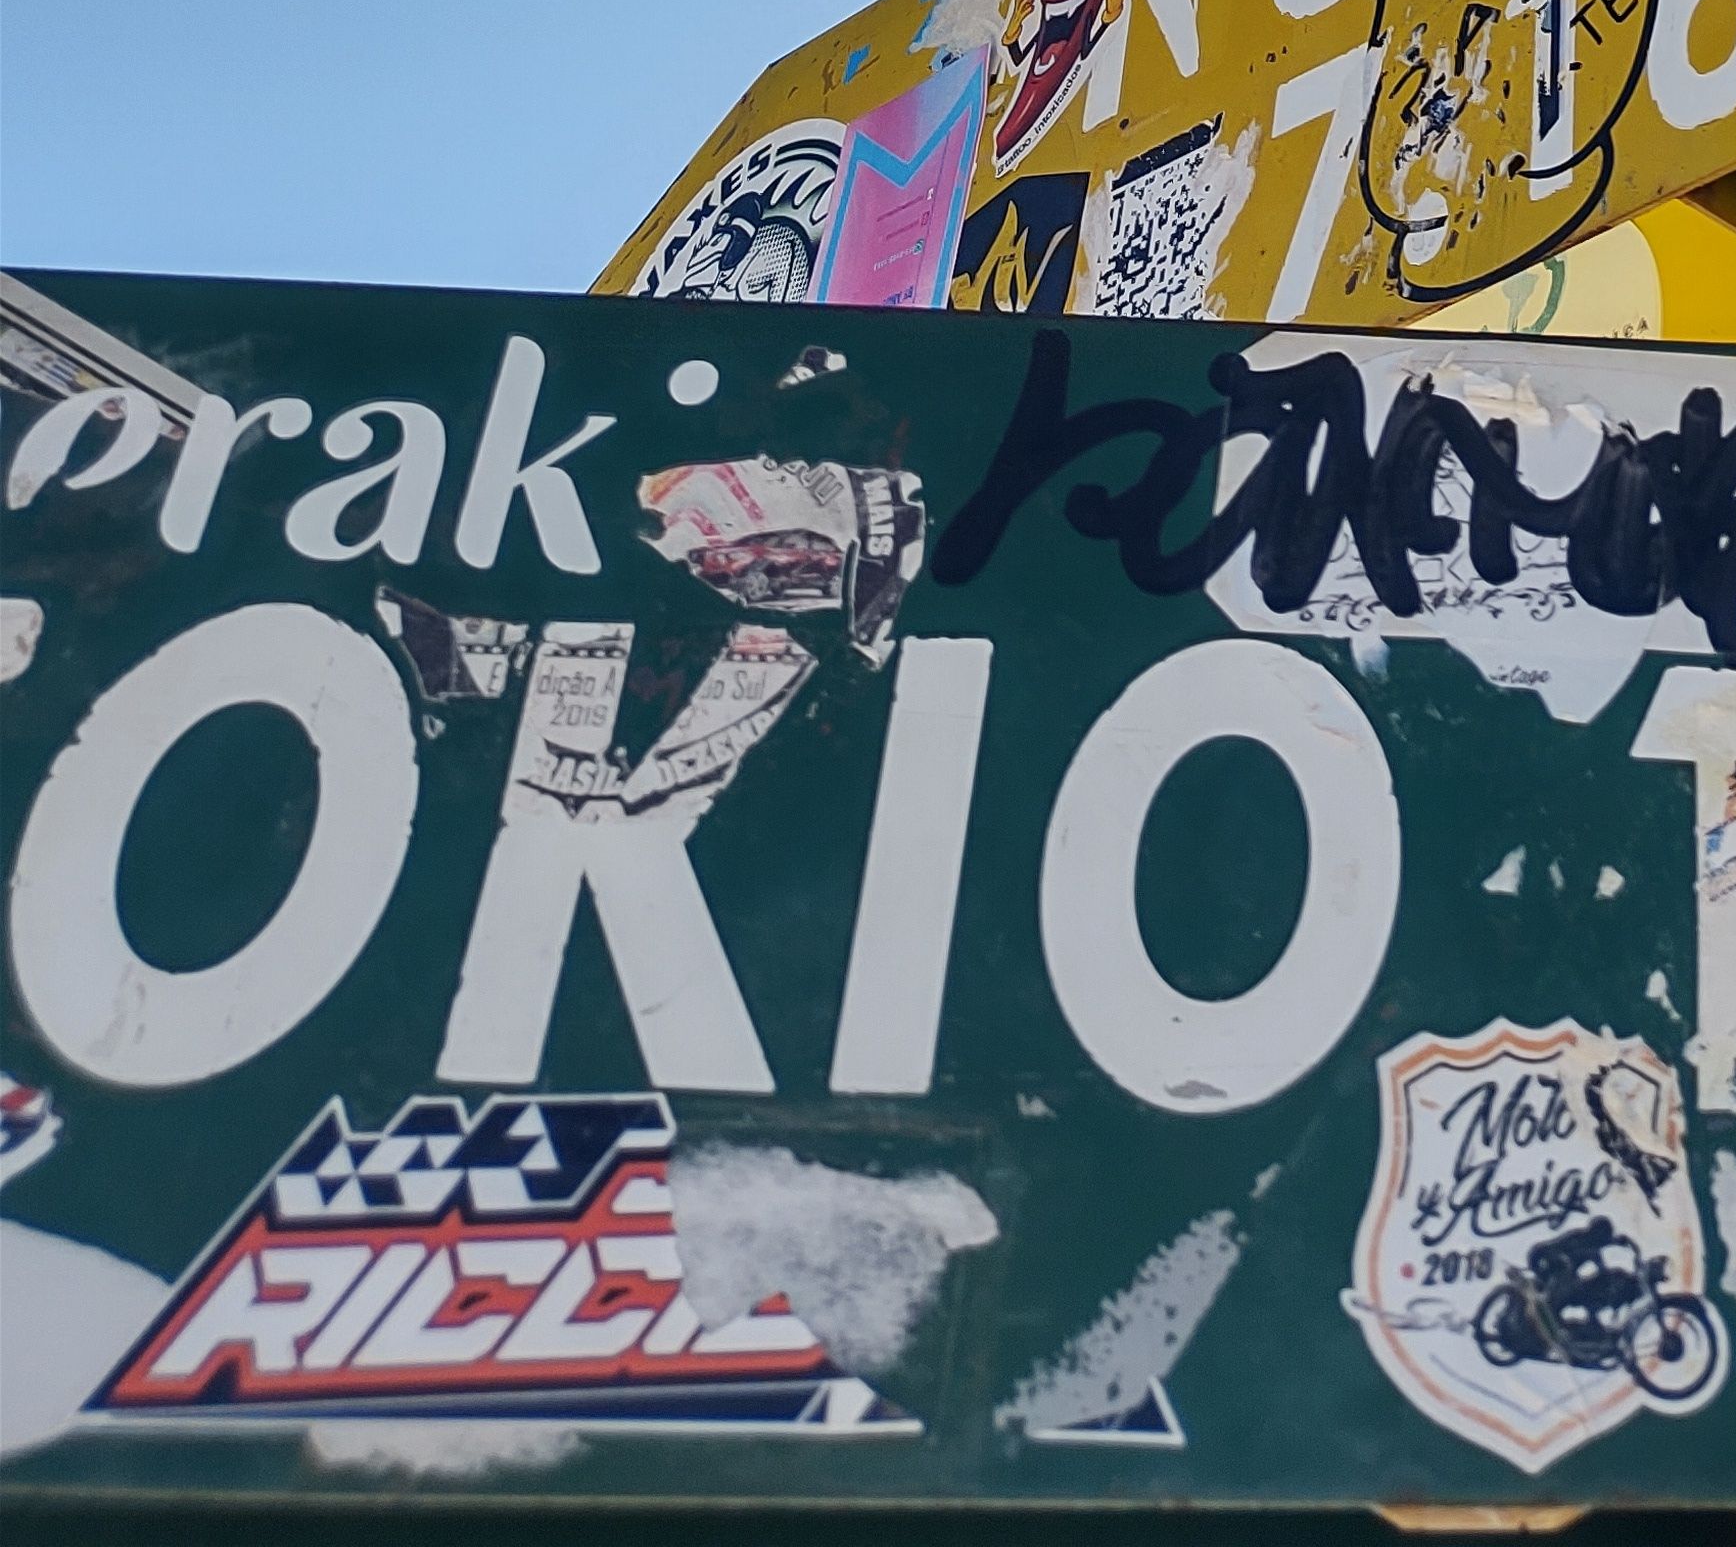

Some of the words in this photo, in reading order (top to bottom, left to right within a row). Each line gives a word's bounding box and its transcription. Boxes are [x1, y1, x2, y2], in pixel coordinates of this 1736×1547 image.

[731, 670, 768, 701] Sul
[549, 704, 609, 728] 2019
[0, 600, 1400, 1117] OKIO
[1420, 1247, 1494, 1287] 2018
